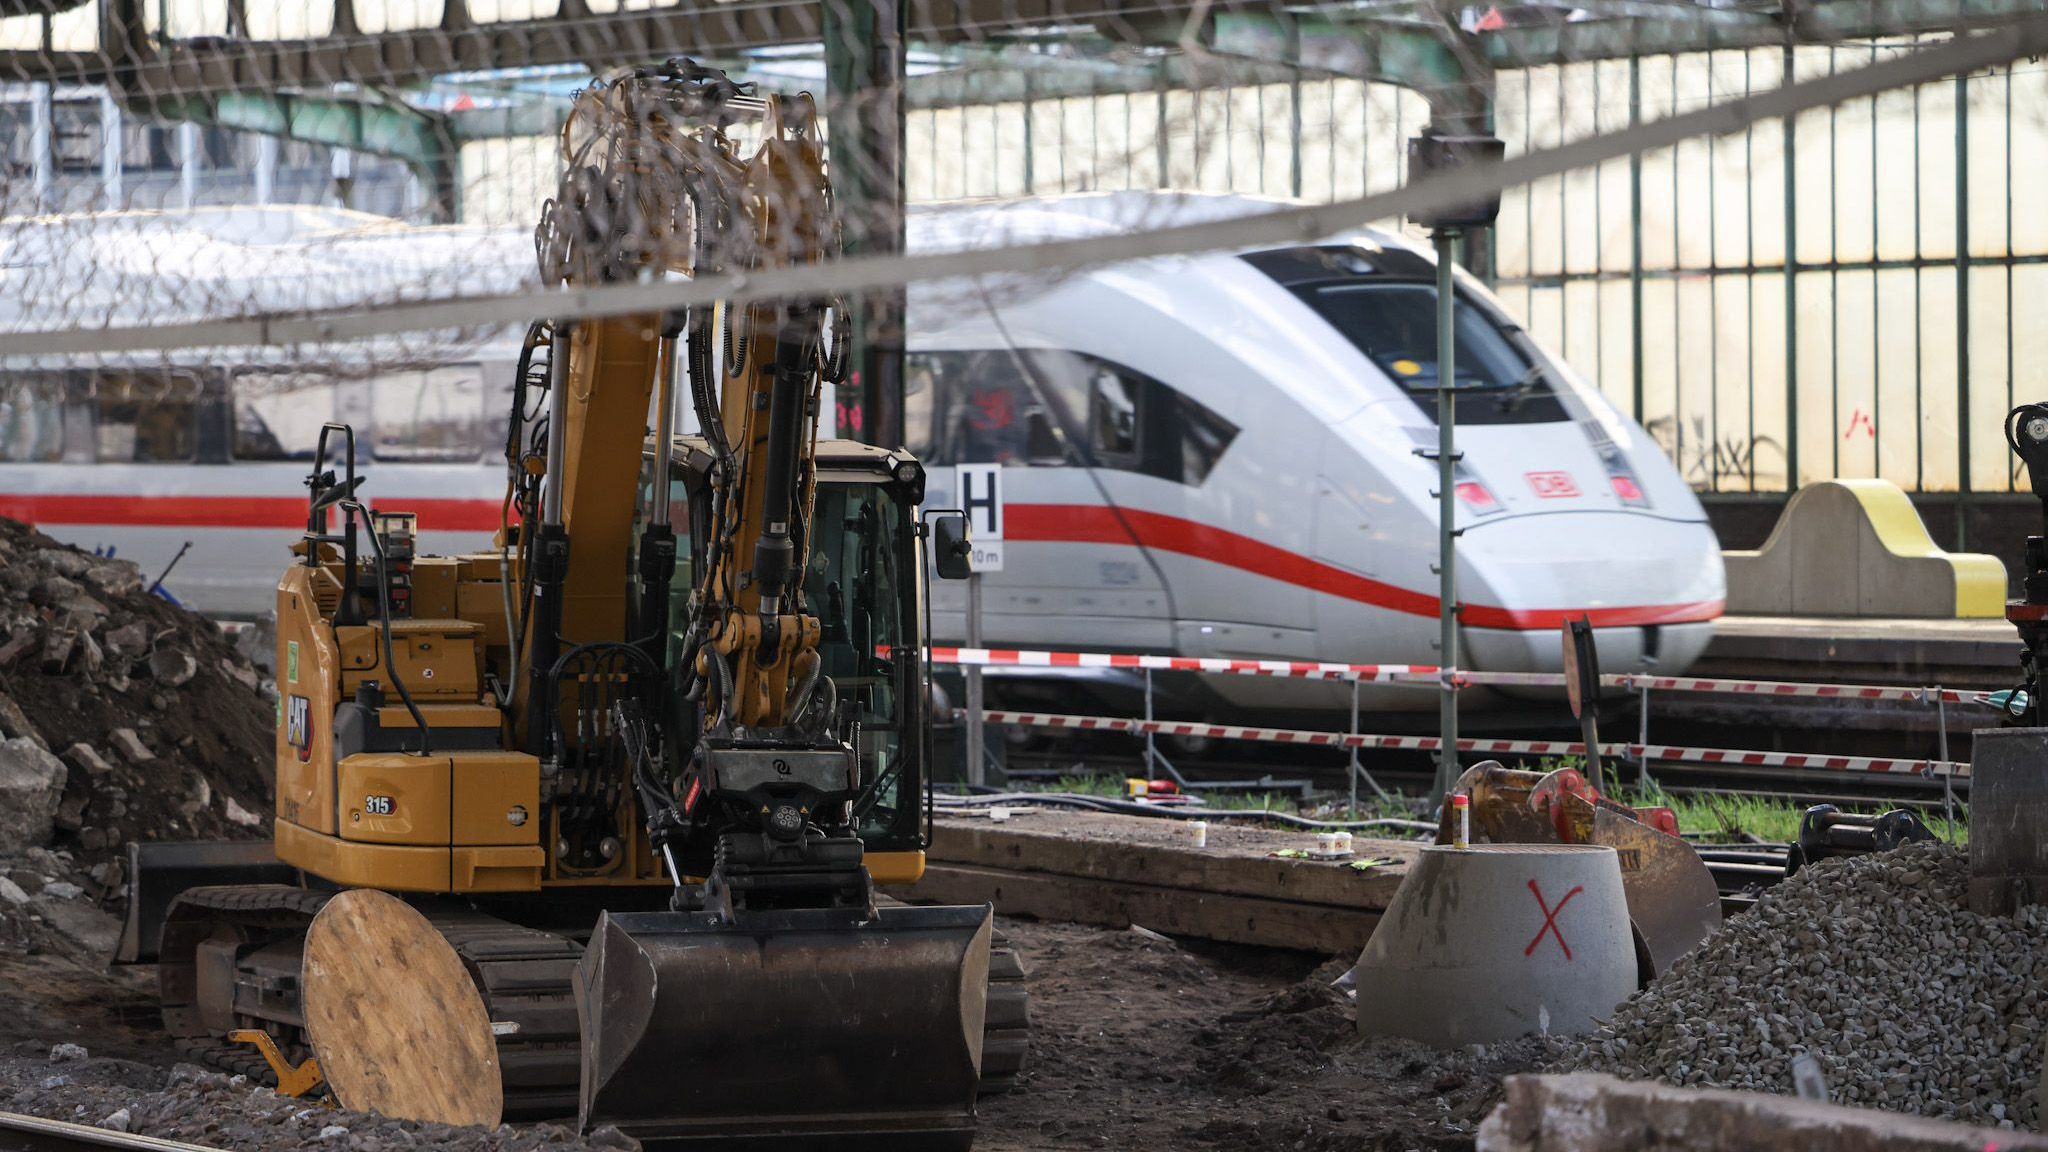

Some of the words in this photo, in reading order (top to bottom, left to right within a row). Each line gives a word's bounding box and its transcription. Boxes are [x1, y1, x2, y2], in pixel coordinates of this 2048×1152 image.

[963, 472, 996, 532] H
[986, 552, 998, 563] m
[288, 694, 308, 746] CAT
[366, 795, 389, 814] 315
